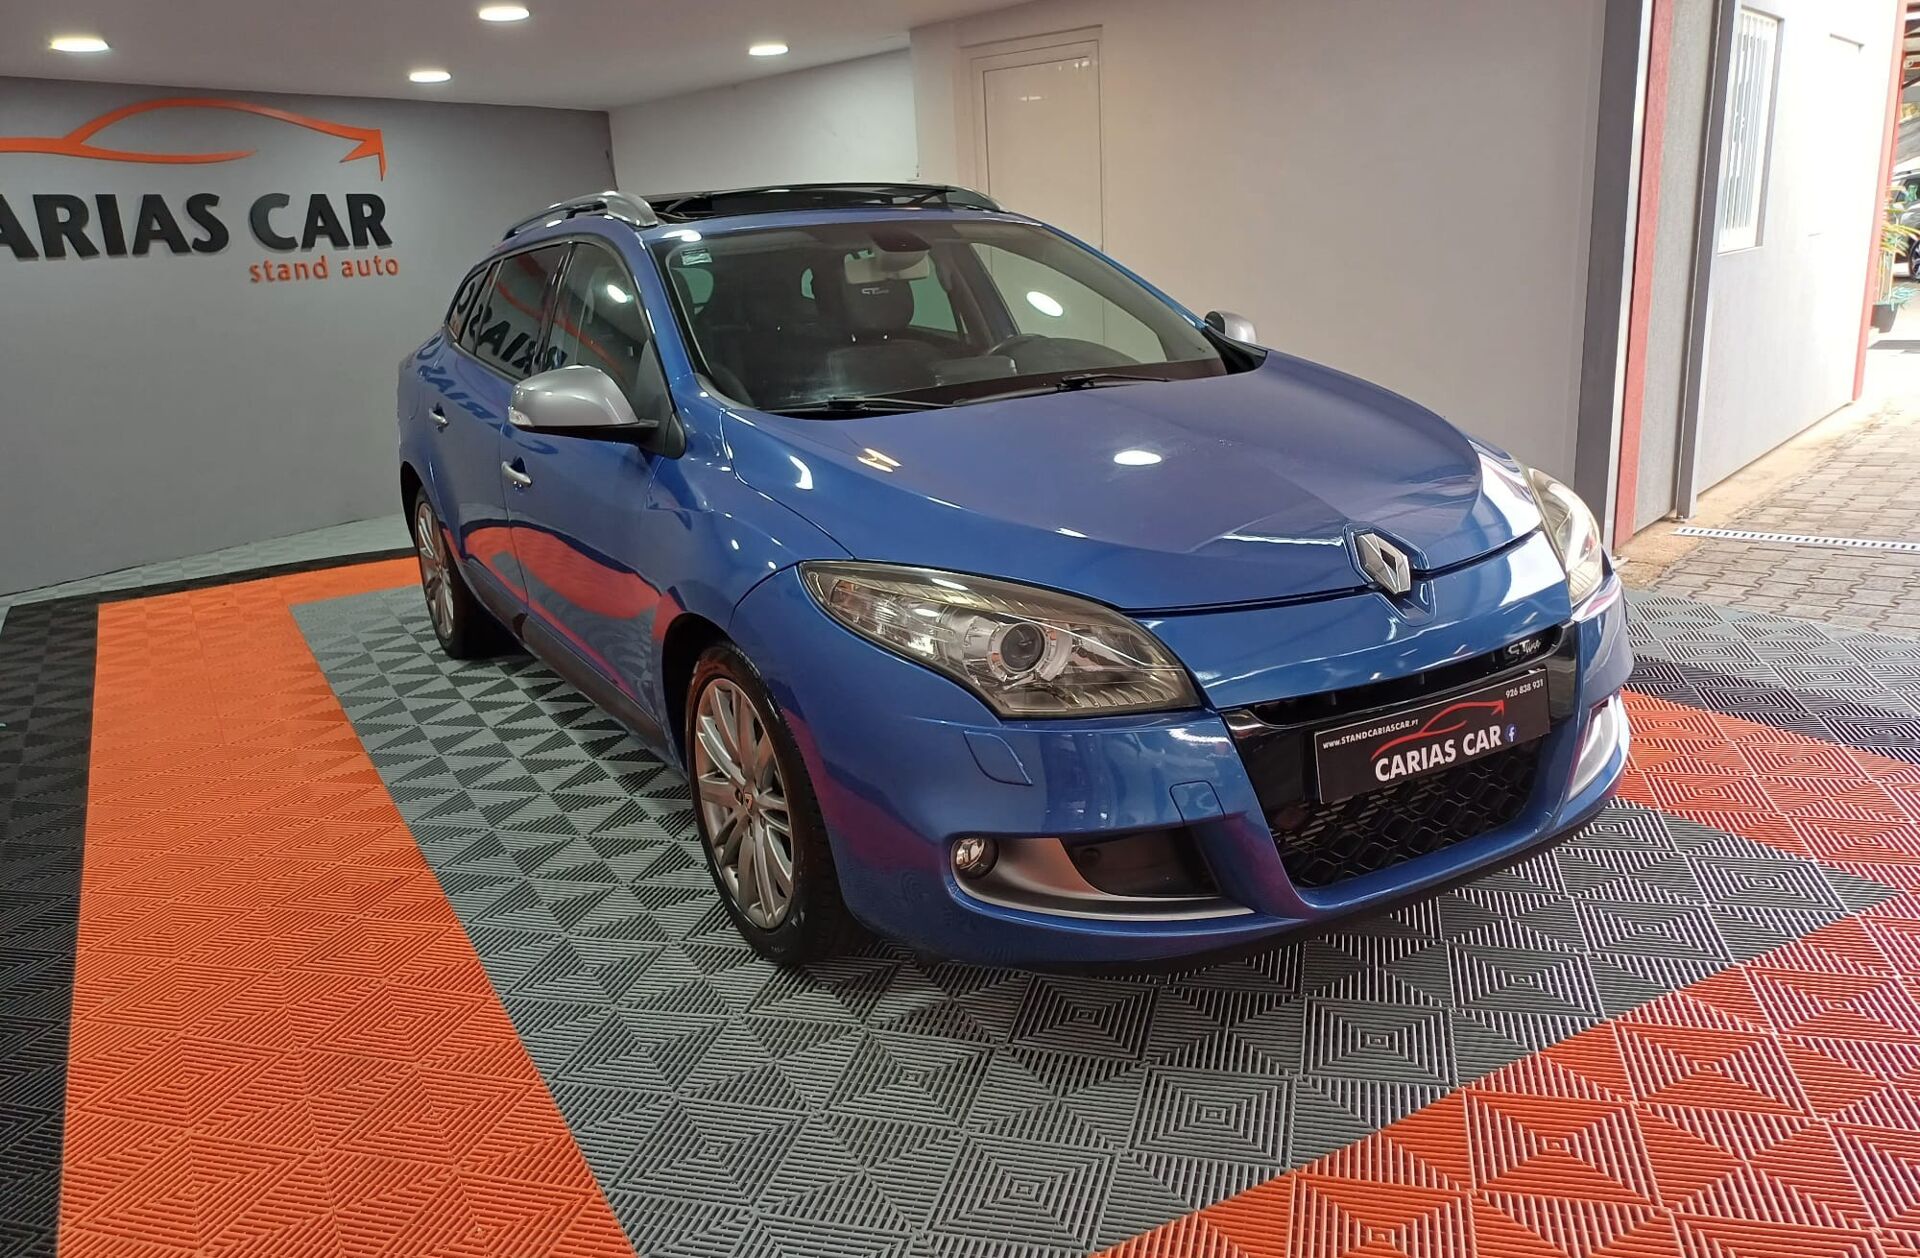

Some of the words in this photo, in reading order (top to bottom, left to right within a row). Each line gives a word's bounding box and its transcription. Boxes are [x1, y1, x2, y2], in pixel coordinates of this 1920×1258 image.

[249, 193, 393, 250] CAR
[249, 255, 329, 283] stand
[341, 255, 399, 277] auto
[1505, 687, 1519, 699] 926
[1532, 678, 1544, 690] 931
[1375, 739, 1457, 782] CARIAS
[1462, 725, 1502, 756] CAR
